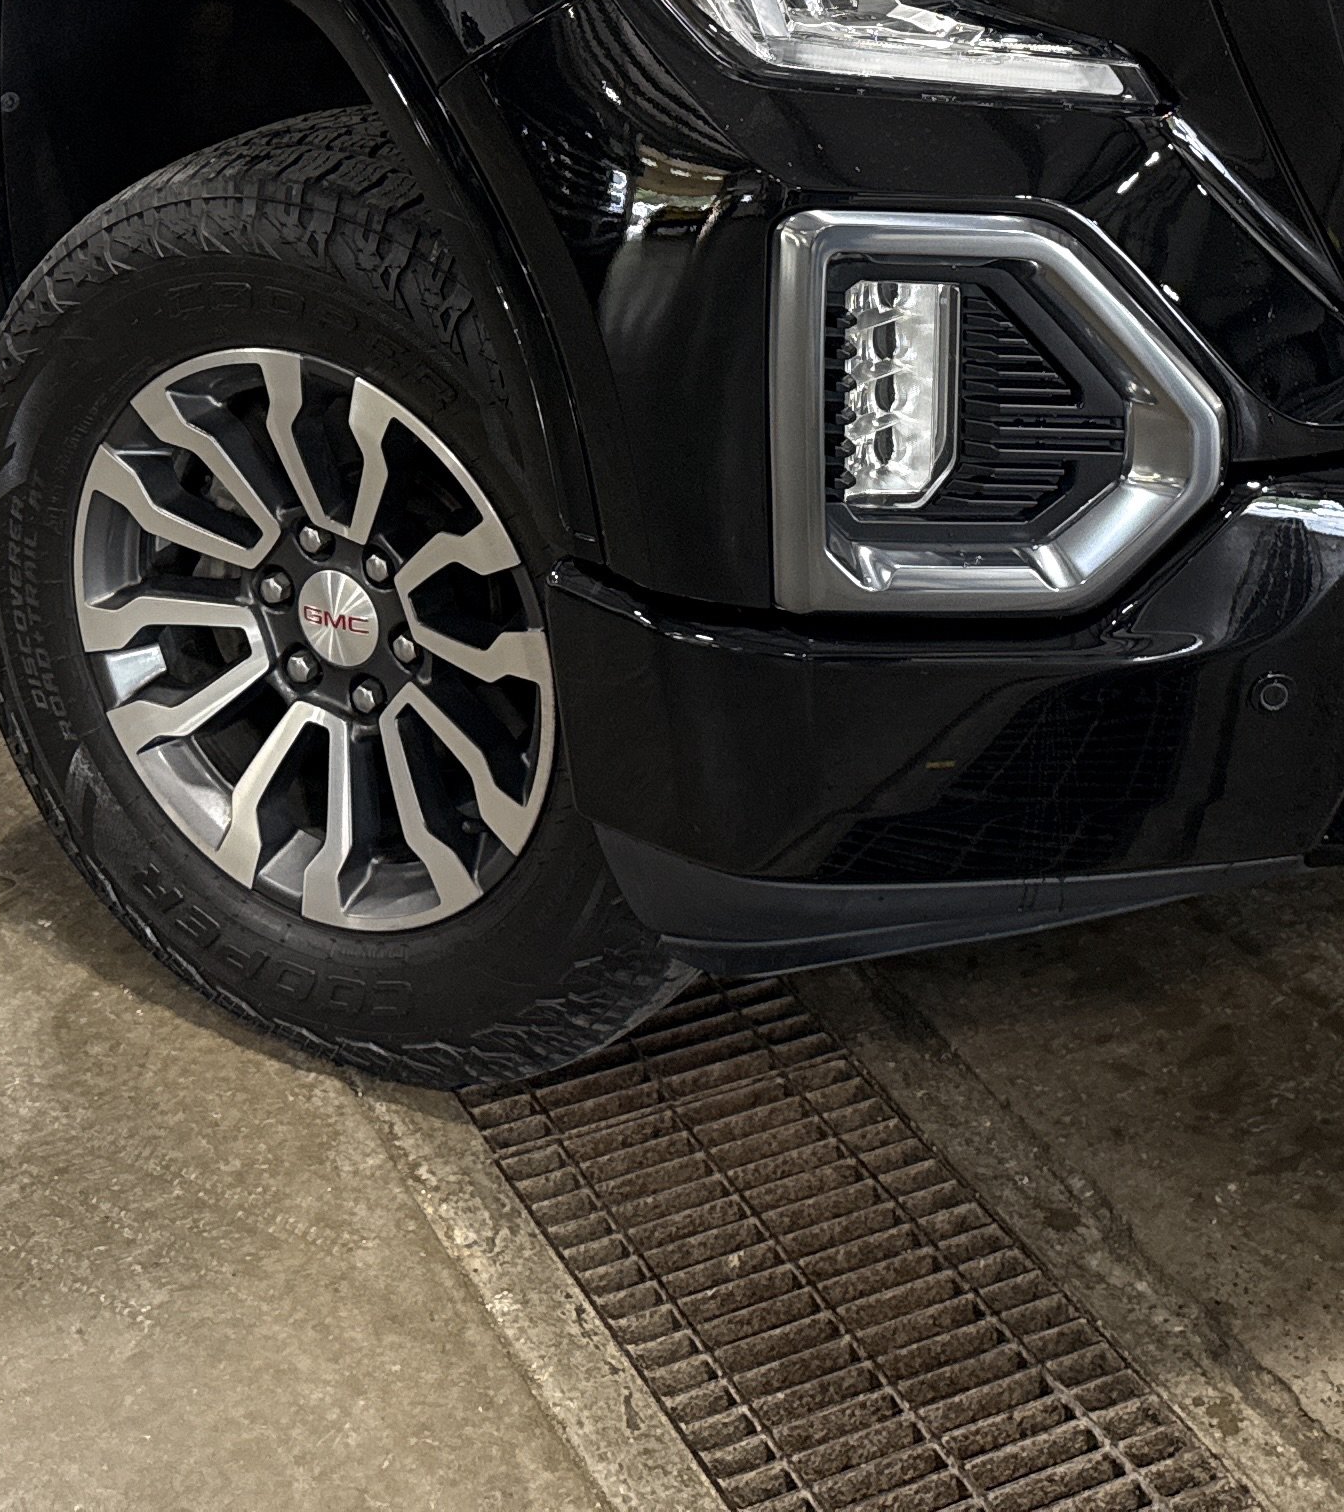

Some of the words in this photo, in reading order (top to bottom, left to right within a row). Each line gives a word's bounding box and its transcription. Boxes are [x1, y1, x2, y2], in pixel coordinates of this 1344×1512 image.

[160, 278, 459, 418] COOPER
[7, 494, 49, 711] DISCOVERER
[23, 530, 79, 742] ROAD+TRAIL
[303, 605, 369, 635] GMC
[134, 861, 412, 1016] COOPER
